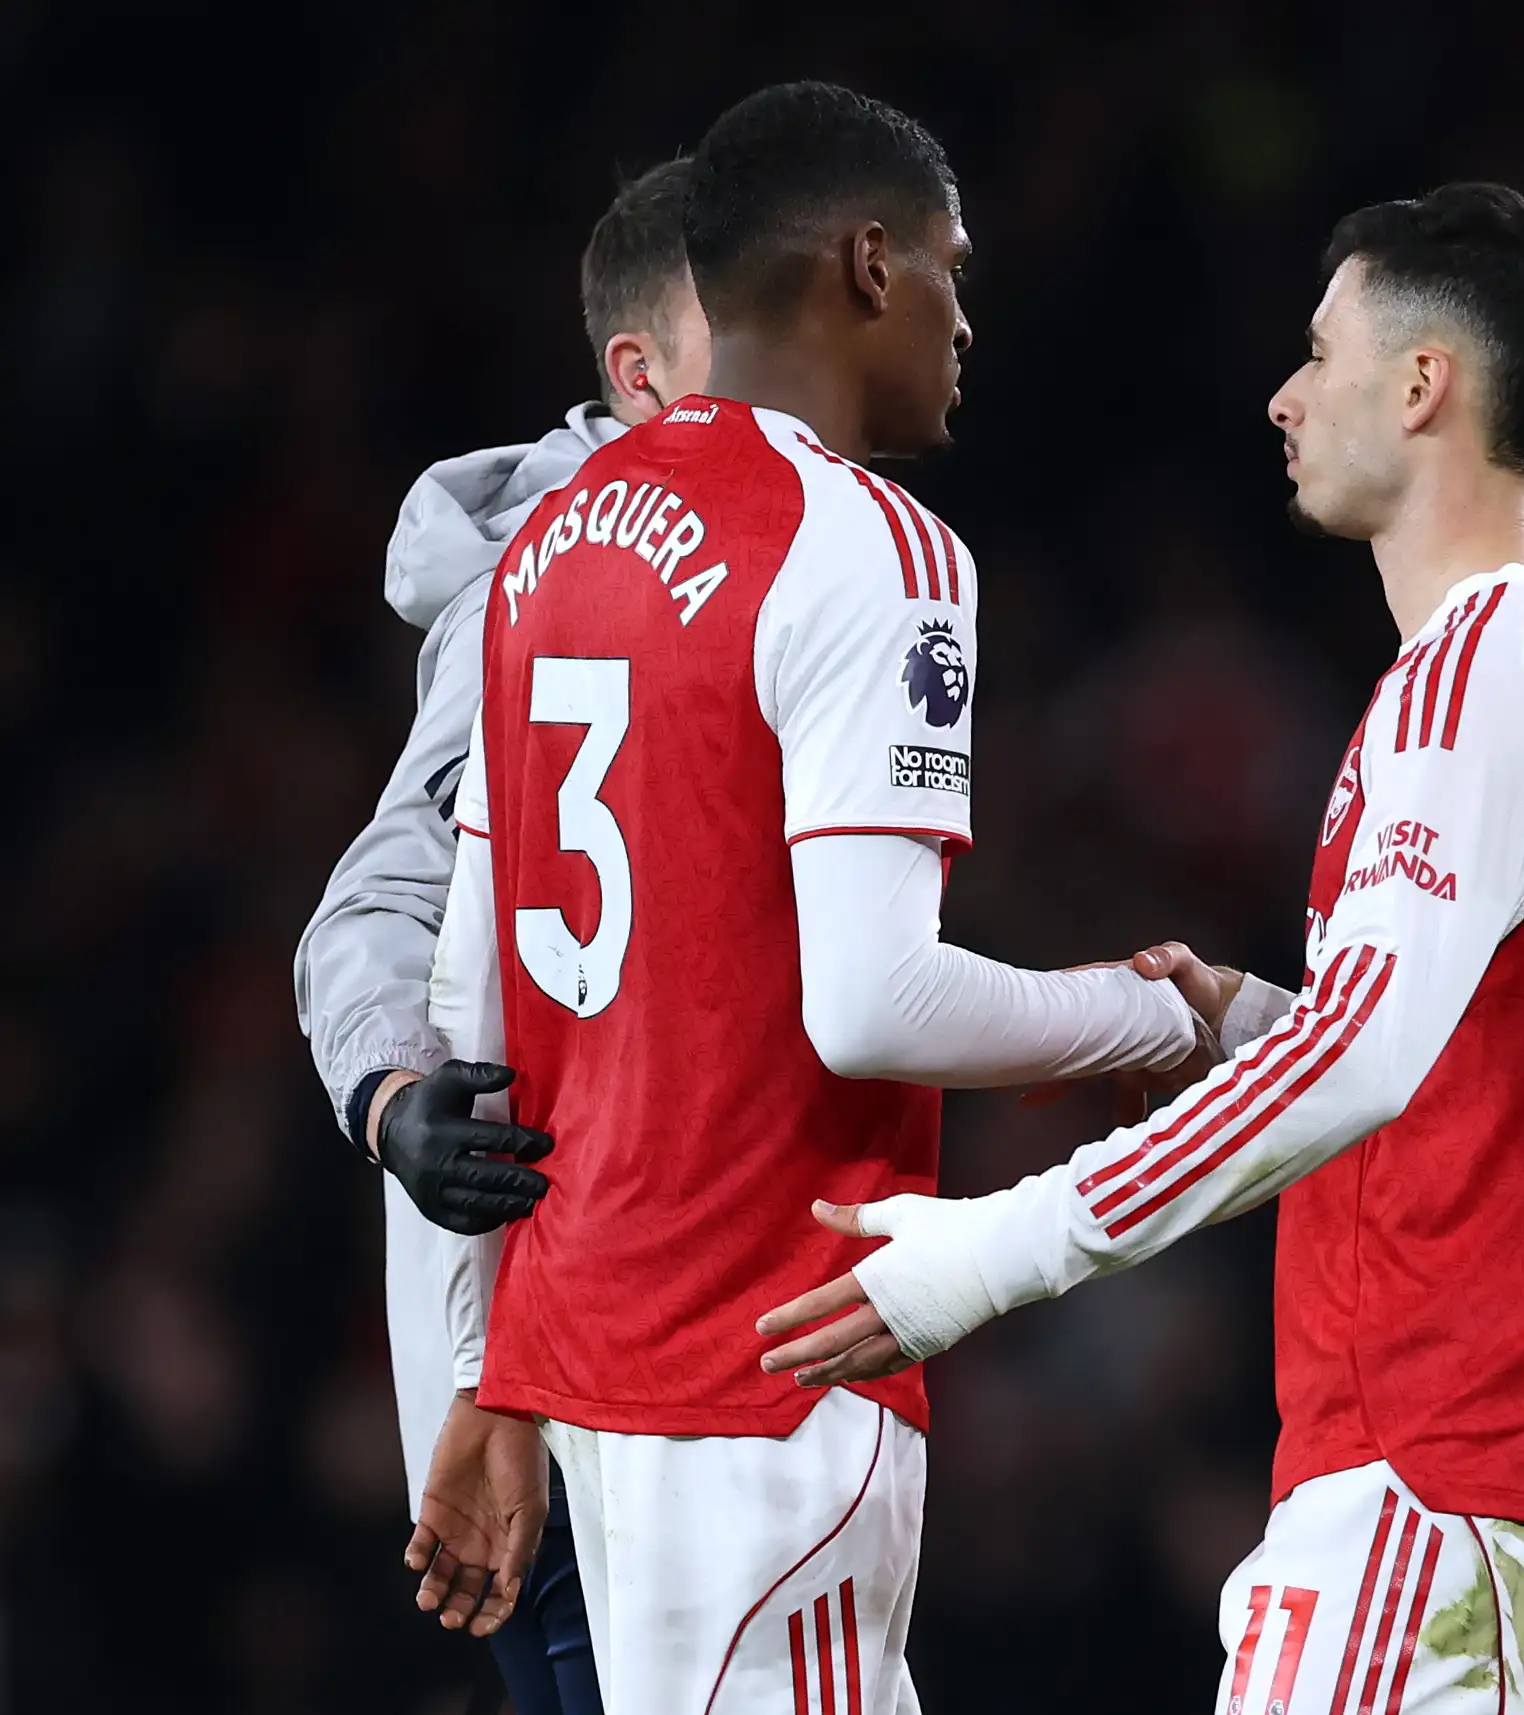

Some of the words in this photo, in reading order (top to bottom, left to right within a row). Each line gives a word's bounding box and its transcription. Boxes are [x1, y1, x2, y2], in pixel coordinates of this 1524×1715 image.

[663, 404, 719, 424] Arsenal
[502, 480, 729, 626] MOSQUERA
[890, 746, 922, 768] No
[925, 752, 966, 777] room
[925, 770, 970, 796] racism
[514, 656, 633, 1018] 3
[1378, 820, 1439, 855] VISIT
[1344, 850, 1457, 901] RWANDA
[1226, 1585, 1320, 1715] 11
